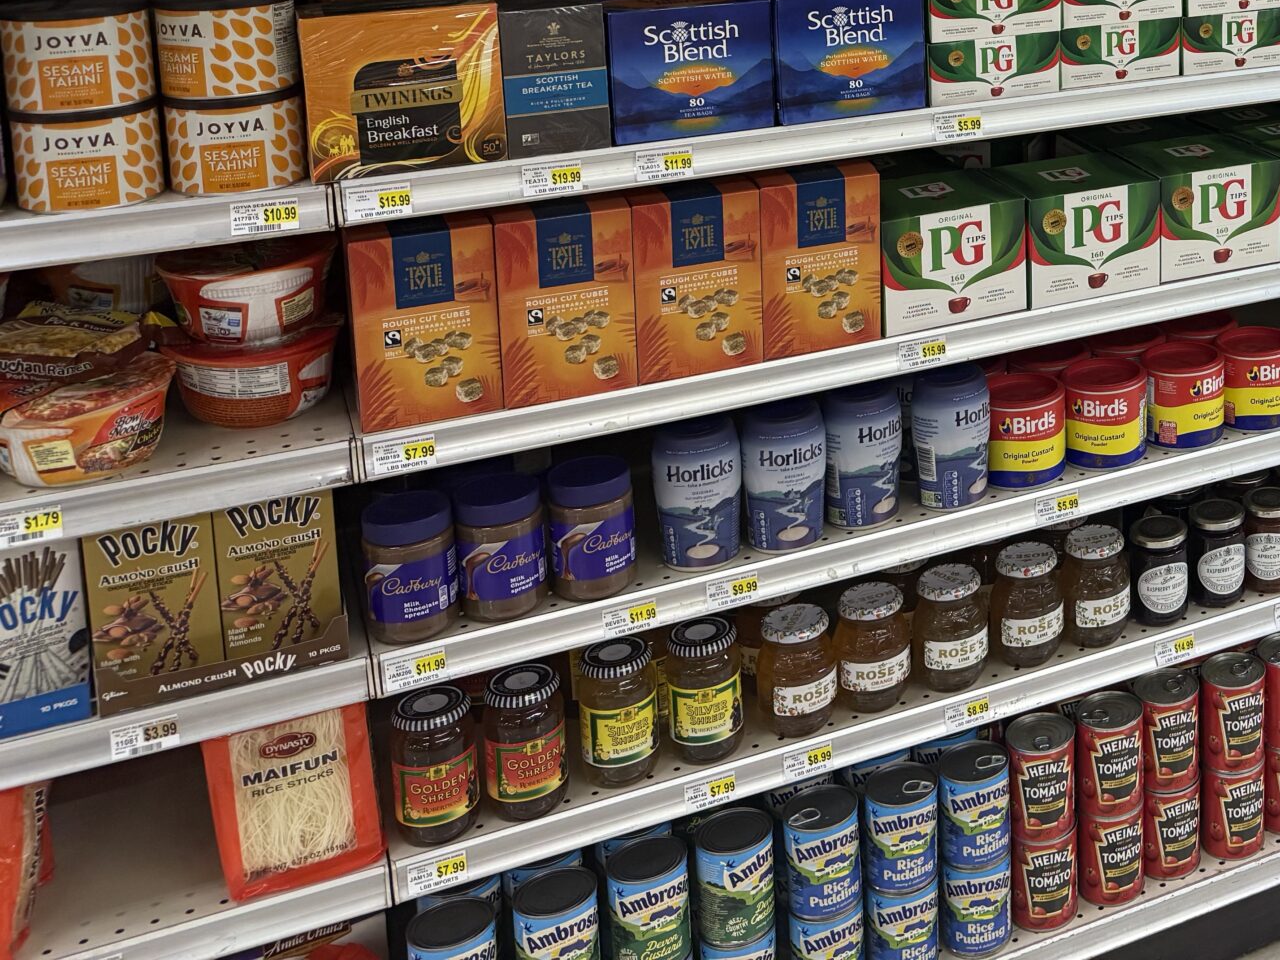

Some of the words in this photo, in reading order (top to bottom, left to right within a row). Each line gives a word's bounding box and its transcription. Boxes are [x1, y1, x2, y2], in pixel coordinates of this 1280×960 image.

[34, 32, 108, 50] JOYVA
[644, 22, 739, 46] Scottish
[526, 51, 585, 63] TAYLORS
[664, 45, 728, 63] Blend
[43, 64, 104, 78] SESAME
[48, 74, 102, 87] TAHINI
[536, 74, 578, 84] SCOTTISH
[522, 82, 573, 93] BREAKFAST
[575, 81, 593, 89] TEA
[362, 87, 453, 107] TWININGS
[689, 97, 704, 107] 80
[366, 115, 409, 130] English
[367, 125, 438, 142] Breakfast
[664, 158, 692, 171] $11.99
[551, 170, 581, 184] $19.99
[379, 194, 411, 209] $15.99
[263, 207, 296, 223] $10.99
[929, 219, 984, 272] PG
[966, 235, 986, 243] TIPS
[950, 274, 965, 282] 160
[526, 297, 556, 308] ROUGH
[579, 289, 609, 299] CUBES
[922, 344, 946, 358] $15.99
[1012, 412, 1056, 432] Bird's
[404, 444, 435, 460] $7.99
[1003, 448, 1033, 460] Original
[1034, 445, 1054, 457] Custard
[667, 460, 734, 483] Horlicks
[24, 512, 59, 529] $1.79
[227, 539, 279, 556] ALMOND
[381, 576, 442, 597] Cadbury
[732, 580, 757, 595] $9.99
[404, 600, 423, 608] Milk
[631, 607, 656, 623] $11.99
[308, 650, 317, 658] 10
[320, 644, 341, 654] PKGS
[1174, 641, 1194, 653] $14.99
[808, 749, 832, 764] $8.99
[242, 751, 339, 787] MAIFUN
[252, 783, 284, 798] RICE
[287, 769, 334, 788] STICKS
[411, 772, 466, 795] GOLDEN
[1025, 783, 1067, 798] TOMATO
[421, 787, 460, 804] SHRED
[809, 889, 860, 906] Pudding
